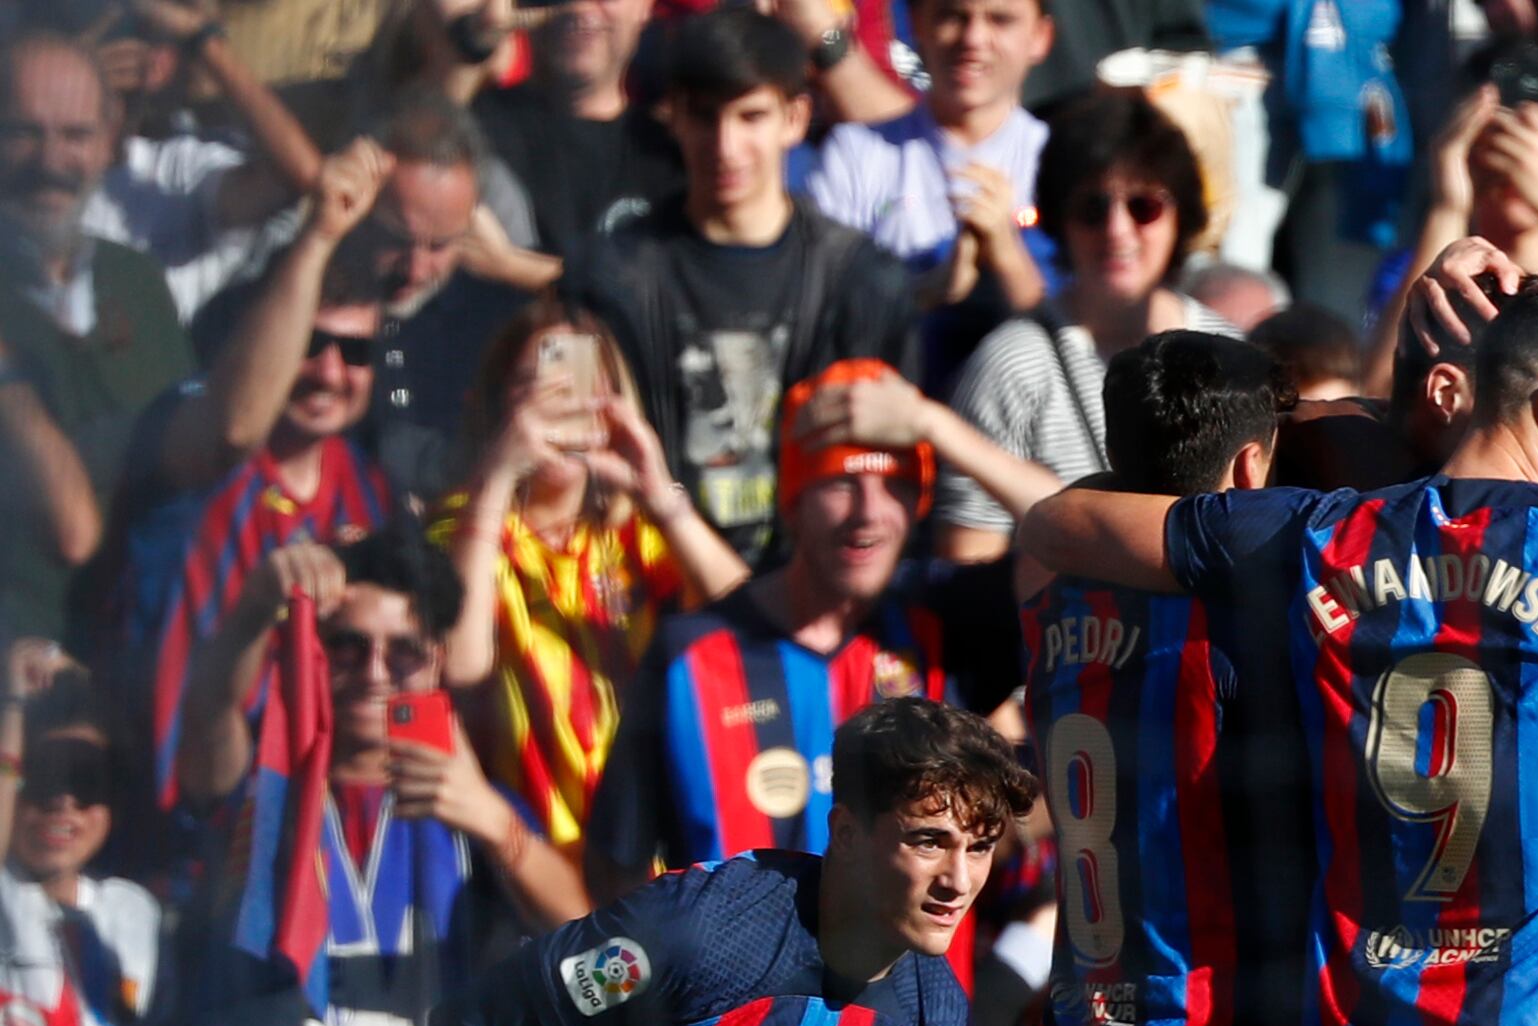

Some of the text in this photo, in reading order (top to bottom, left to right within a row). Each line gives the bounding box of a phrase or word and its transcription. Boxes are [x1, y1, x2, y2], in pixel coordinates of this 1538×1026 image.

[1045, 615, 1141, 673] PEDRI
[1046, 713, 1125, 968] 8
[1365, 653, 1496, 902] 9
[574, 961, 602, 1008] LaLiga
